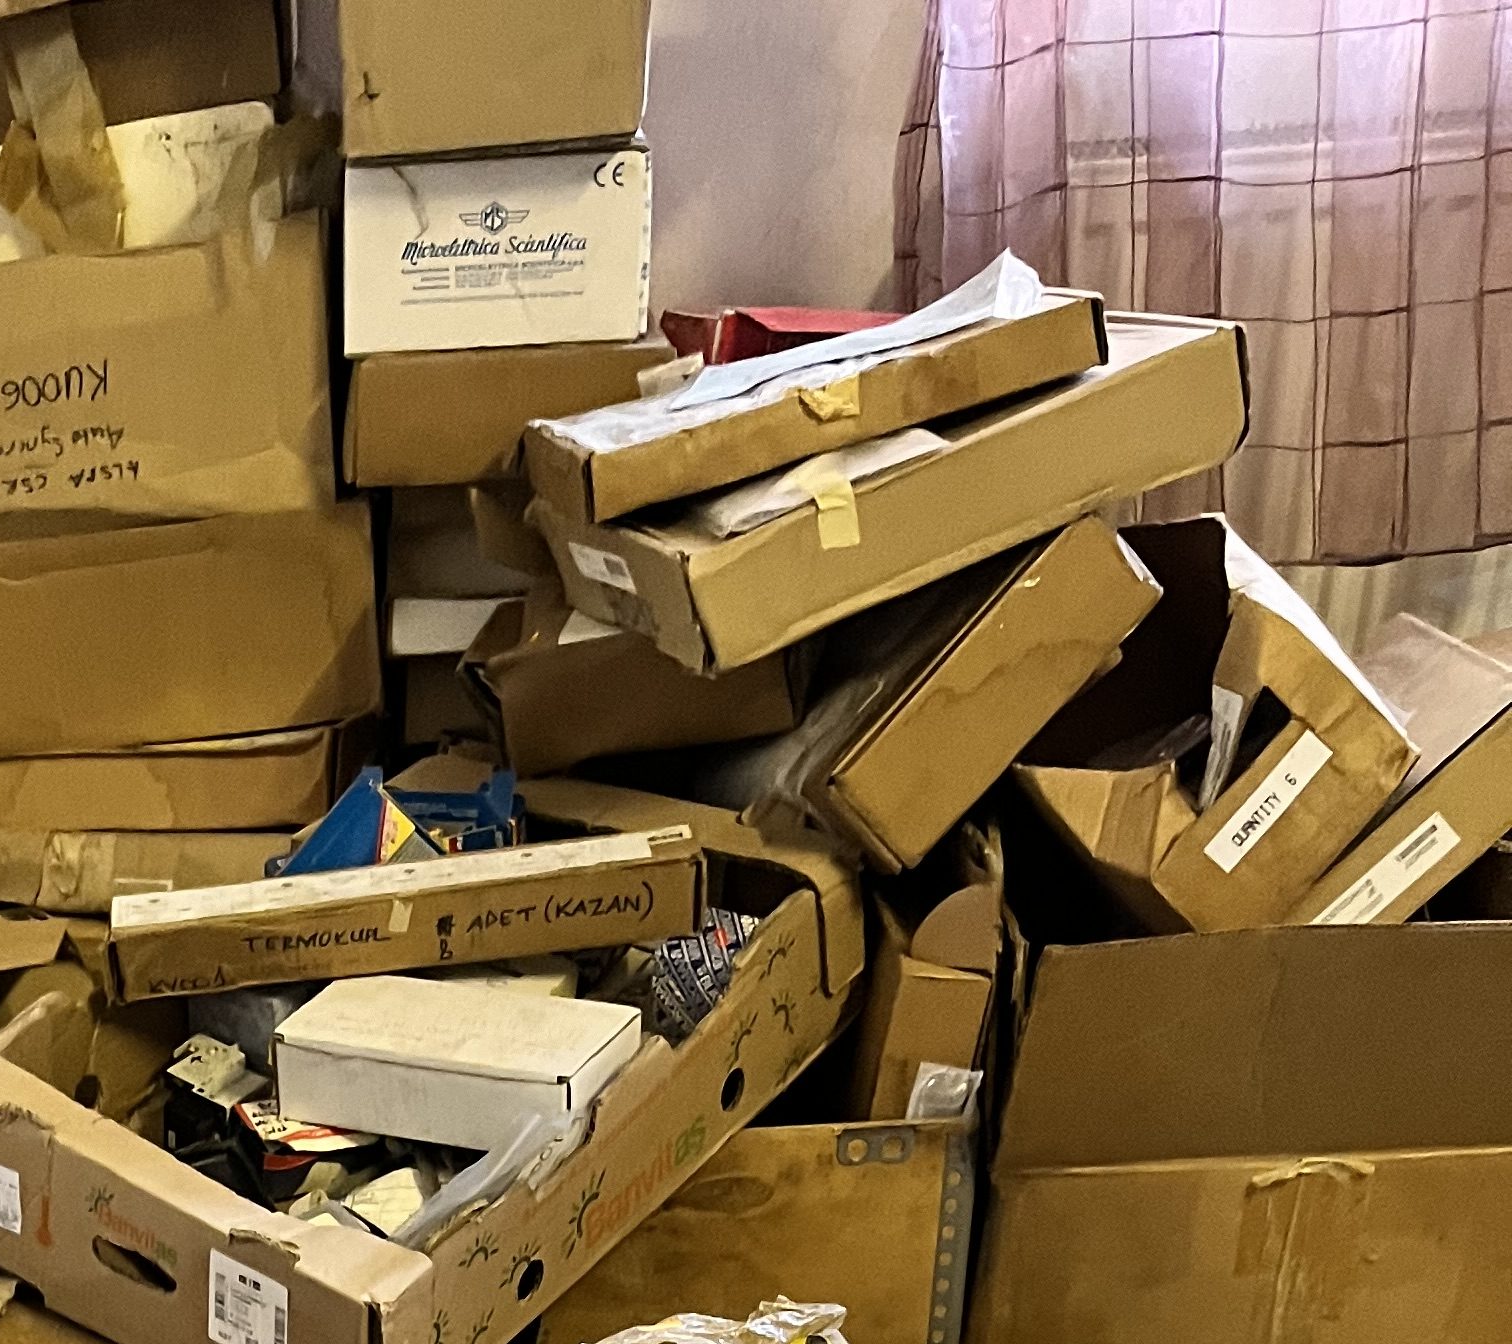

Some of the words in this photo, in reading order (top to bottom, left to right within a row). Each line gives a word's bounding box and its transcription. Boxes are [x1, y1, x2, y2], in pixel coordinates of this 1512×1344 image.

[504, 232, 587, 260] Scientifica
[0, 358, 109, 412] KU006
[1231, 791, 1282, 847] QUANTITY
[1284, 772, 1297, 786] 6
[466, 907, 538, 936] ADET
[543, 880, 655, 923] (KAZAN)
